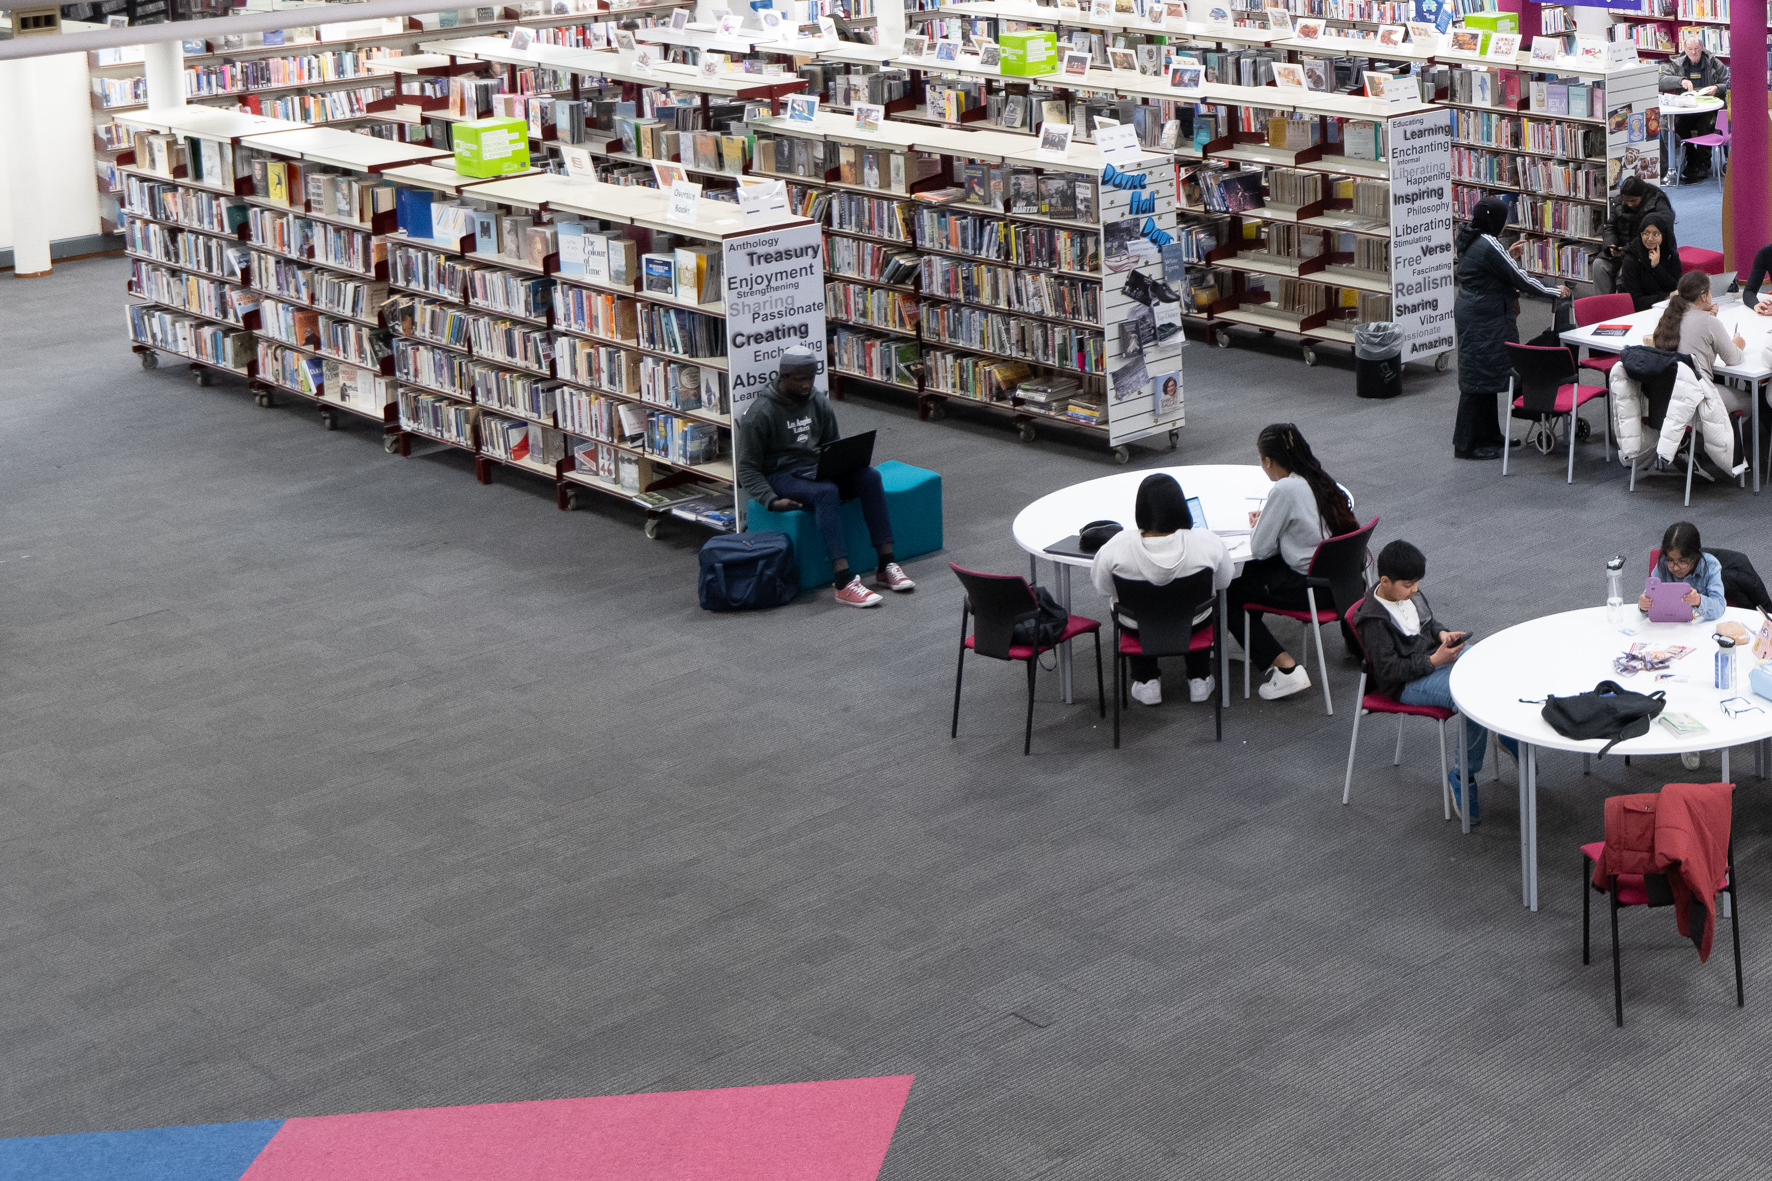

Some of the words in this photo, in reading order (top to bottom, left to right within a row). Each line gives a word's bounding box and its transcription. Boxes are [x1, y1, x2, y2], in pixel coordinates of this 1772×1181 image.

[1393, 118, 1424, 128] Educating
[1403, 125, 1451, 141] Learning
[1392, 141, 1449, 159] Enchanting
[1397, 156, 1420, 166] Informal
[1101, 163, 1148, 190] Dance
[1393, 162, 1445, 180] Liberating
[1406, 171, 1451, 186] Happening
[674, 188, 696, 201] Oversize
[1393, 186, 1444, 205] Inspiring
[675, 204, 690, 215] Books
[1129, 191, 1155, 215] Hall
[1407, 202, 1450, 217] Philosophy
[1395, 218, 1451, 238] Liberating
[582, 237, 596, 246] The
[729, 238, 779, 252] Anthology
[1394, 234, 1431, 248] Stimulating
[583, 247, 606, 257] Colour
[747, 244, 820, 267] Treasury
[1421, 243, 1451, 257] Verse
[583, 257, 591, 265] of
[1395, 254, 1422, 270] Free
[1412, 262, 1452, 276] Fascinating
[584, 264, 602, 276] Time
[728, 263, 814, 291] Enjoyment
[737, 281, 800, 299] Strengthening
[1396, 274, 1452, 299] Realism
[730, 295, 795, 318] Sharing
[752, 302, 824, 323] Passionate
[1396, 298, 1439, 317] Sharing
[1420, 310, 1454, 326] Vibrant
[732, 323, 809, 349] Creating
[1410, 335, 1454, 355] Amazing
